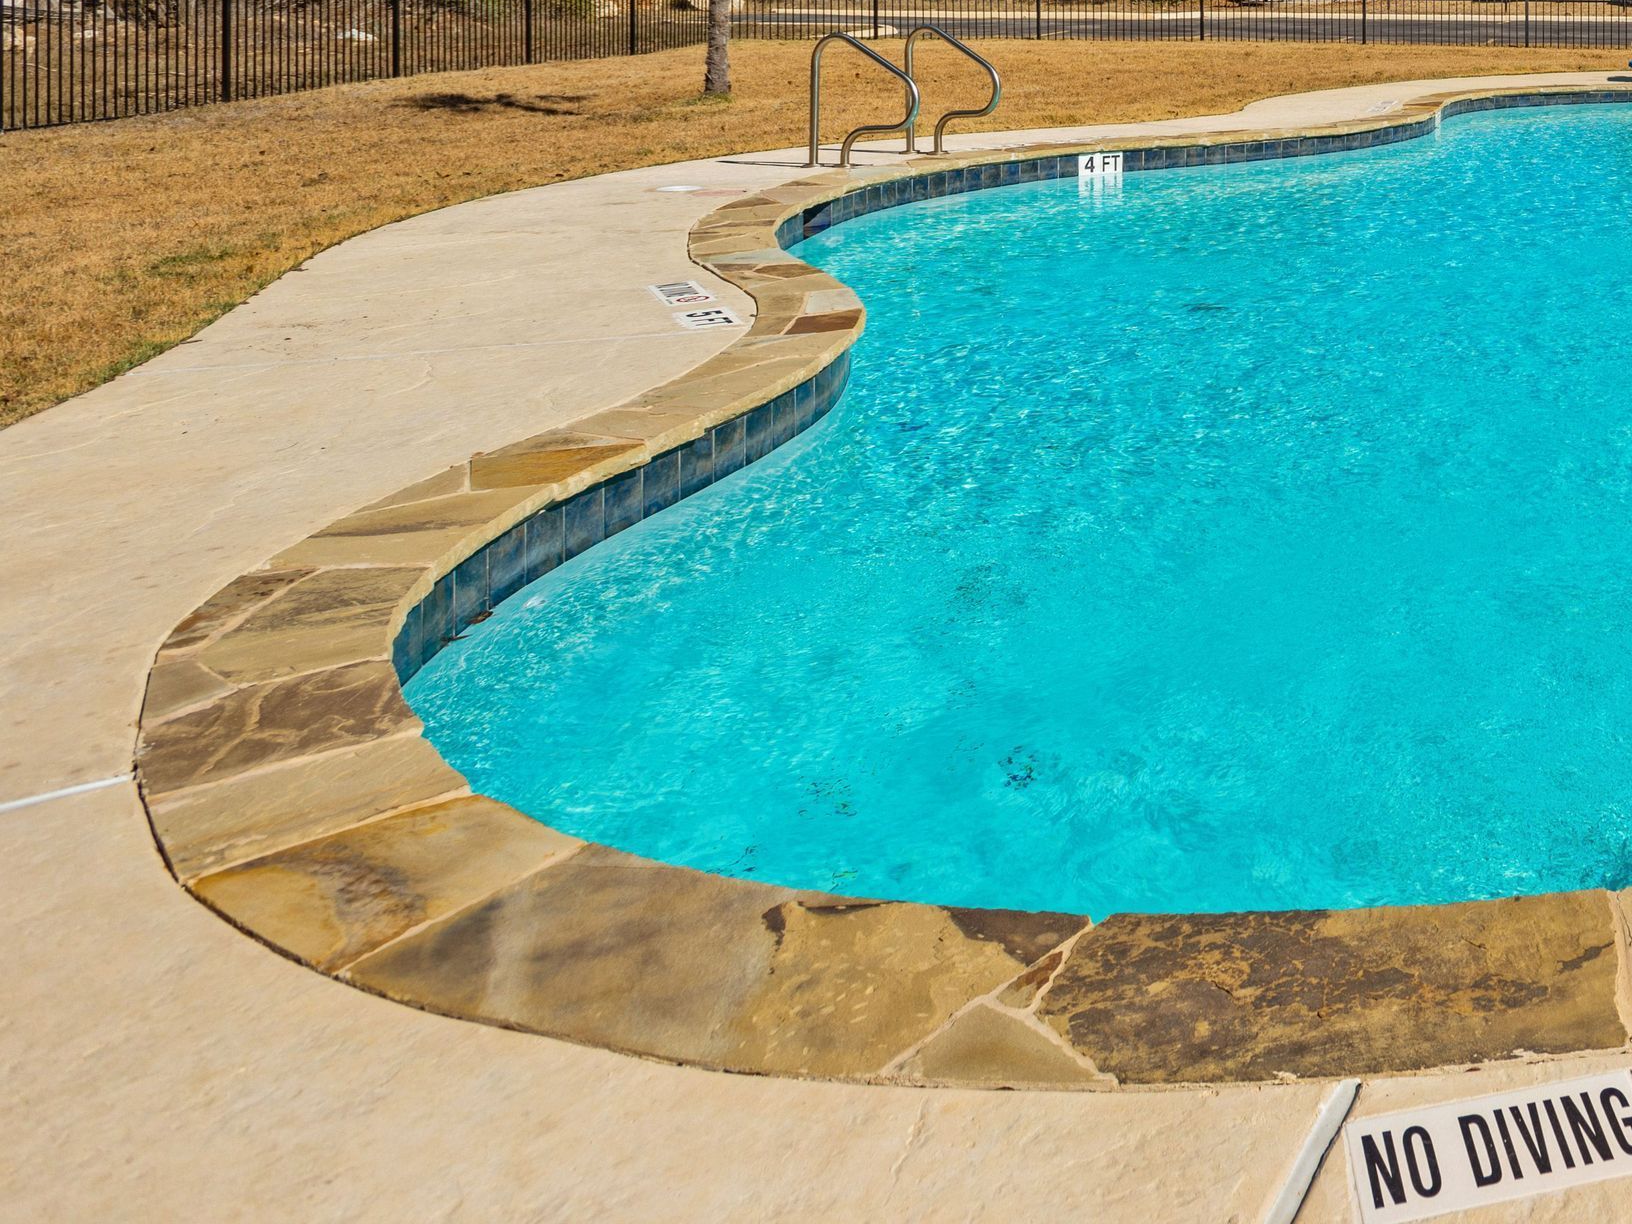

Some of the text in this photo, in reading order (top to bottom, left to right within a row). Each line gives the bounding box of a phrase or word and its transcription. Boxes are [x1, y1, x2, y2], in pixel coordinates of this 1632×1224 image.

[1084, 155, 1121, 173] 4 FT
[685, 309, 734, 326] 5 FT
[1361, 1125, 1443, 1210] NO
